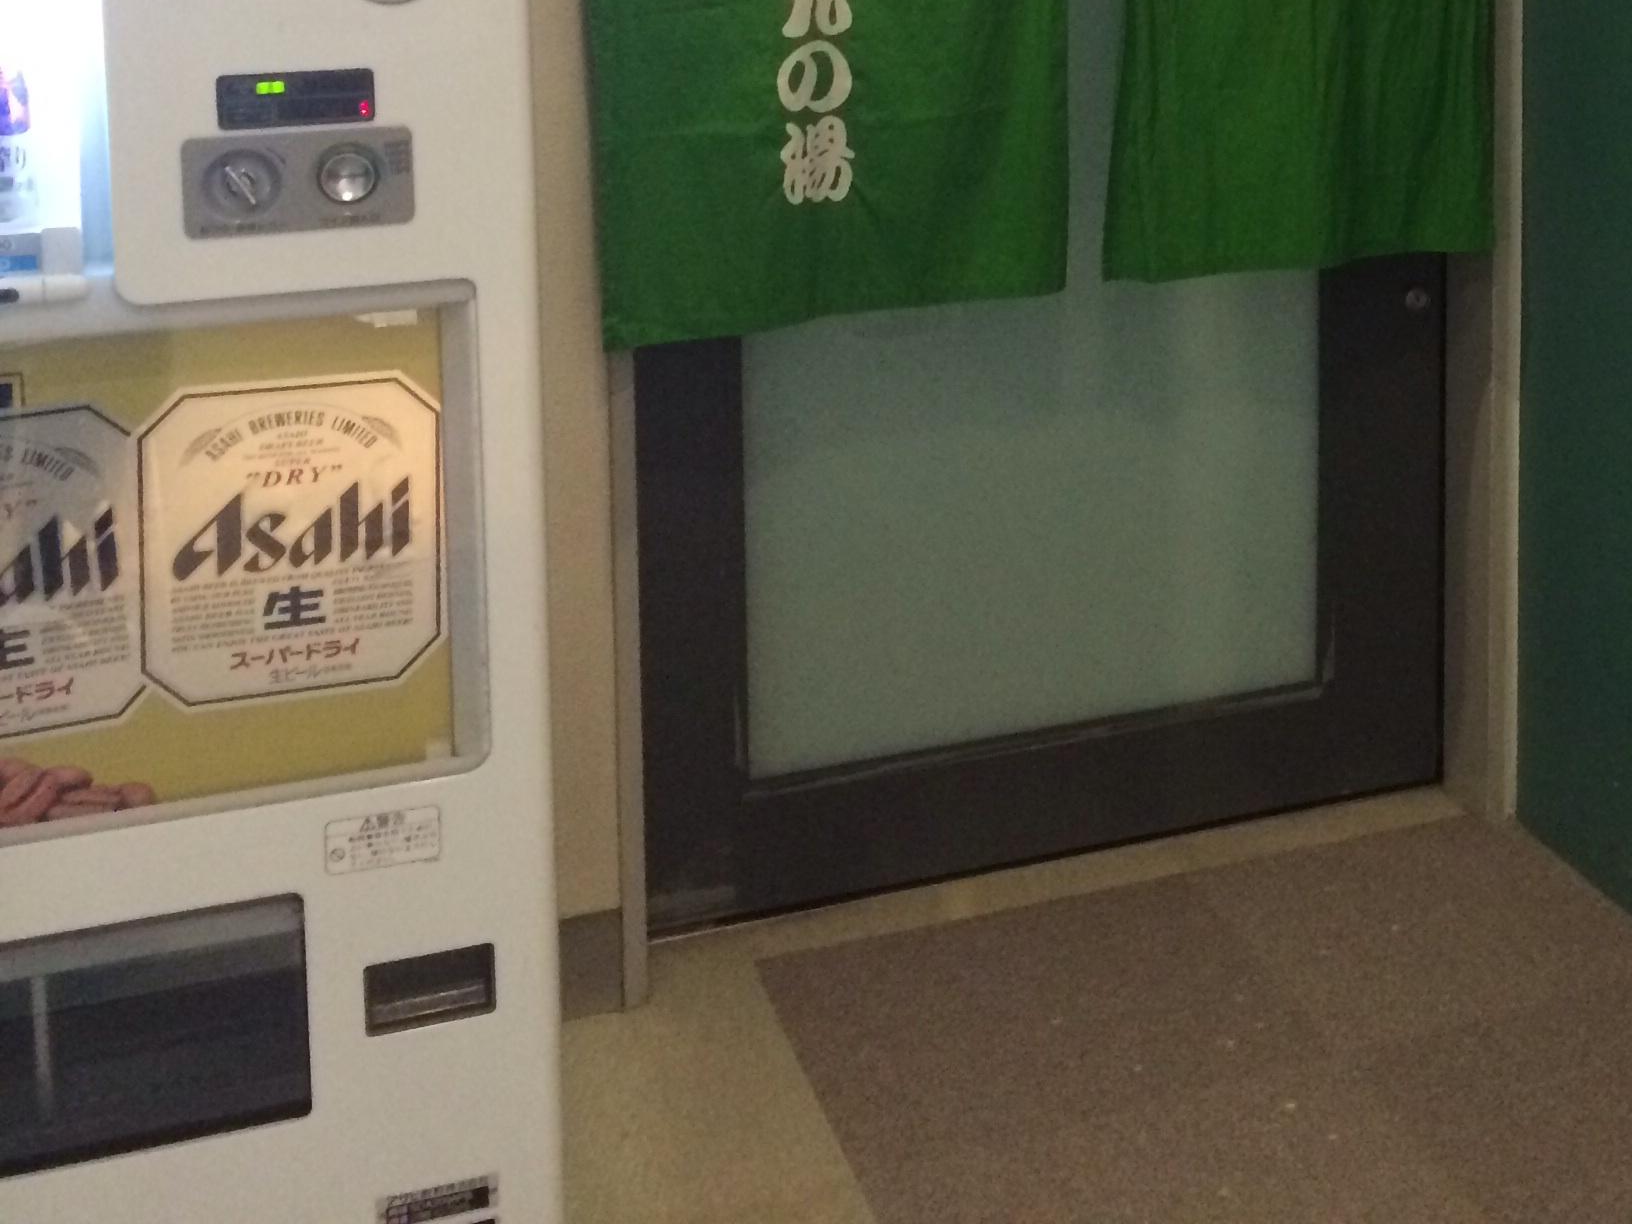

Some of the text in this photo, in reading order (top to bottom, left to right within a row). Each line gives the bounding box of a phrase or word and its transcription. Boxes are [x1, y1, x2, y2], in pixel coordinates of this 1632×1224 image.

[248, 411, 325, 435] BREWERIES
[172, 475, 410, 582] Asahi
[263, 586, 327, 631] 生
[229, 637, 360, 670] スーパードライ
